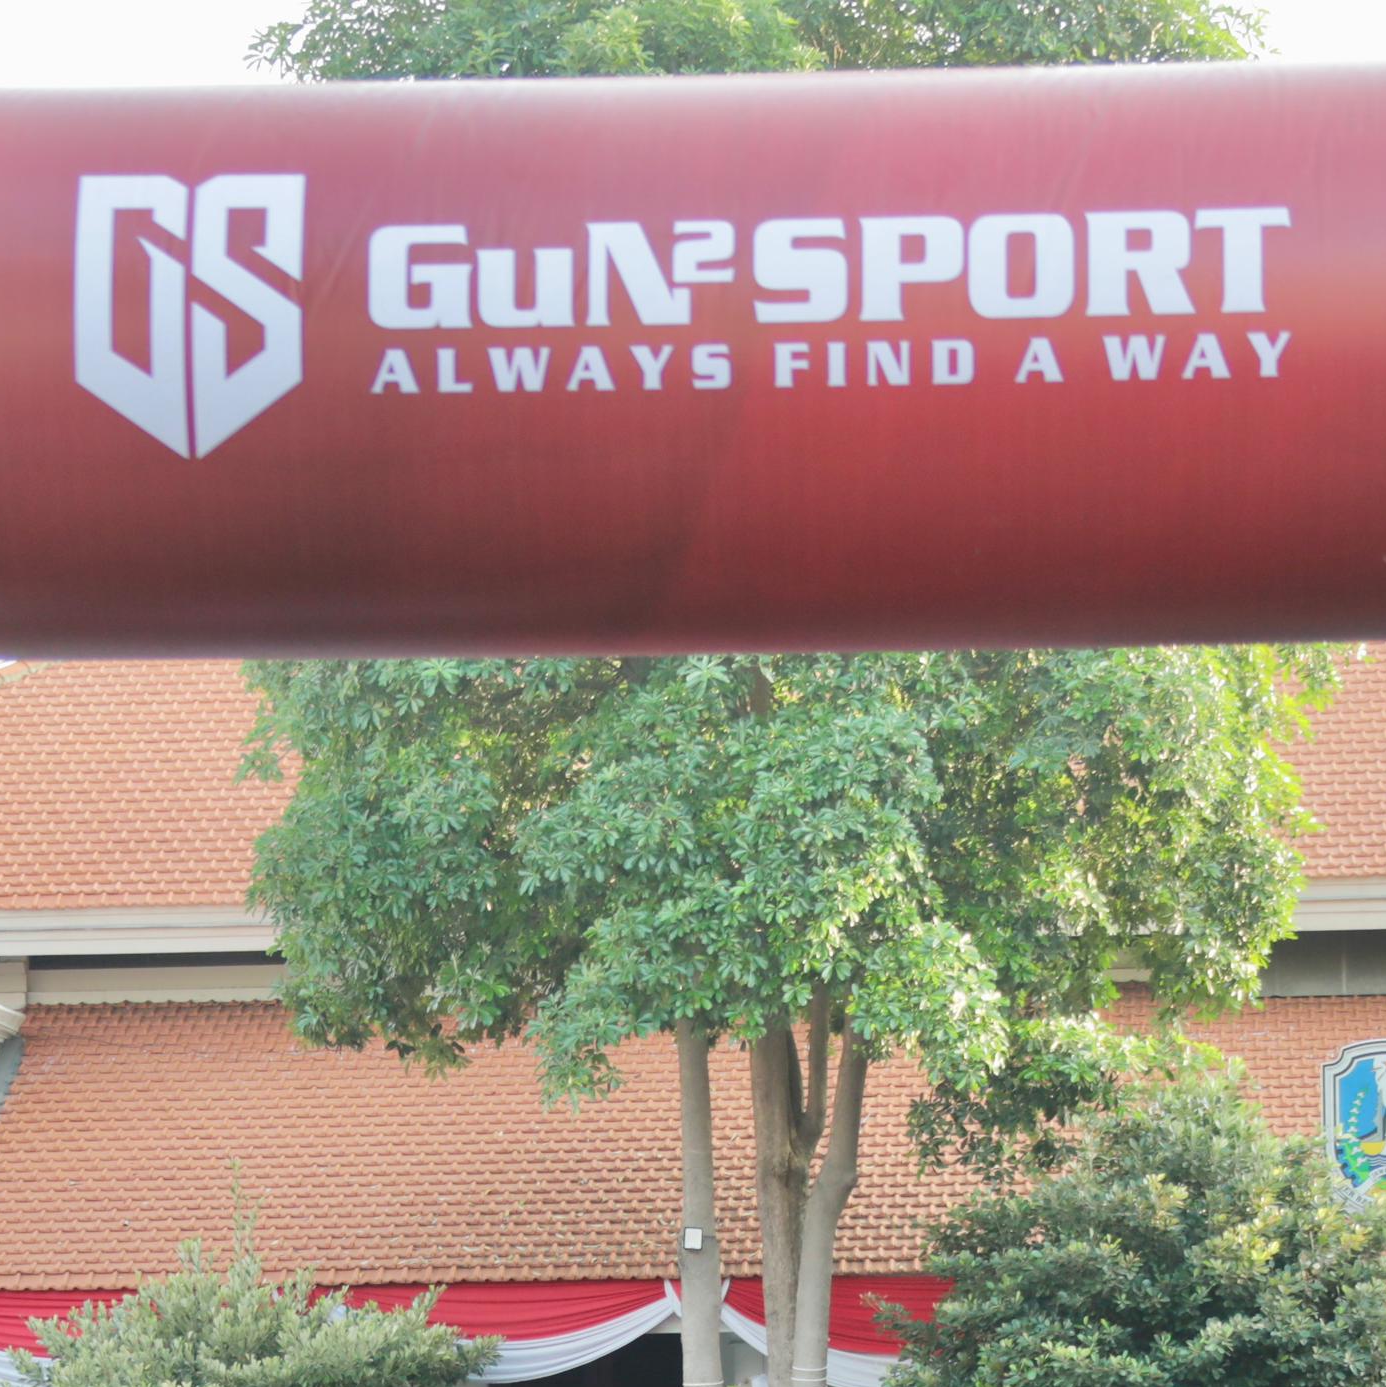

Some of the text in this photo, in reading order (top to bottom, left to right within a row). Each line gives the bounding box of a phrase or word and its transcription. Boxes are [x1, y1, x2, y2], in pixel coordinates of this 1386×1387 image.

[372, 331, 1291, 394] ALWAYS FIND A WAY
